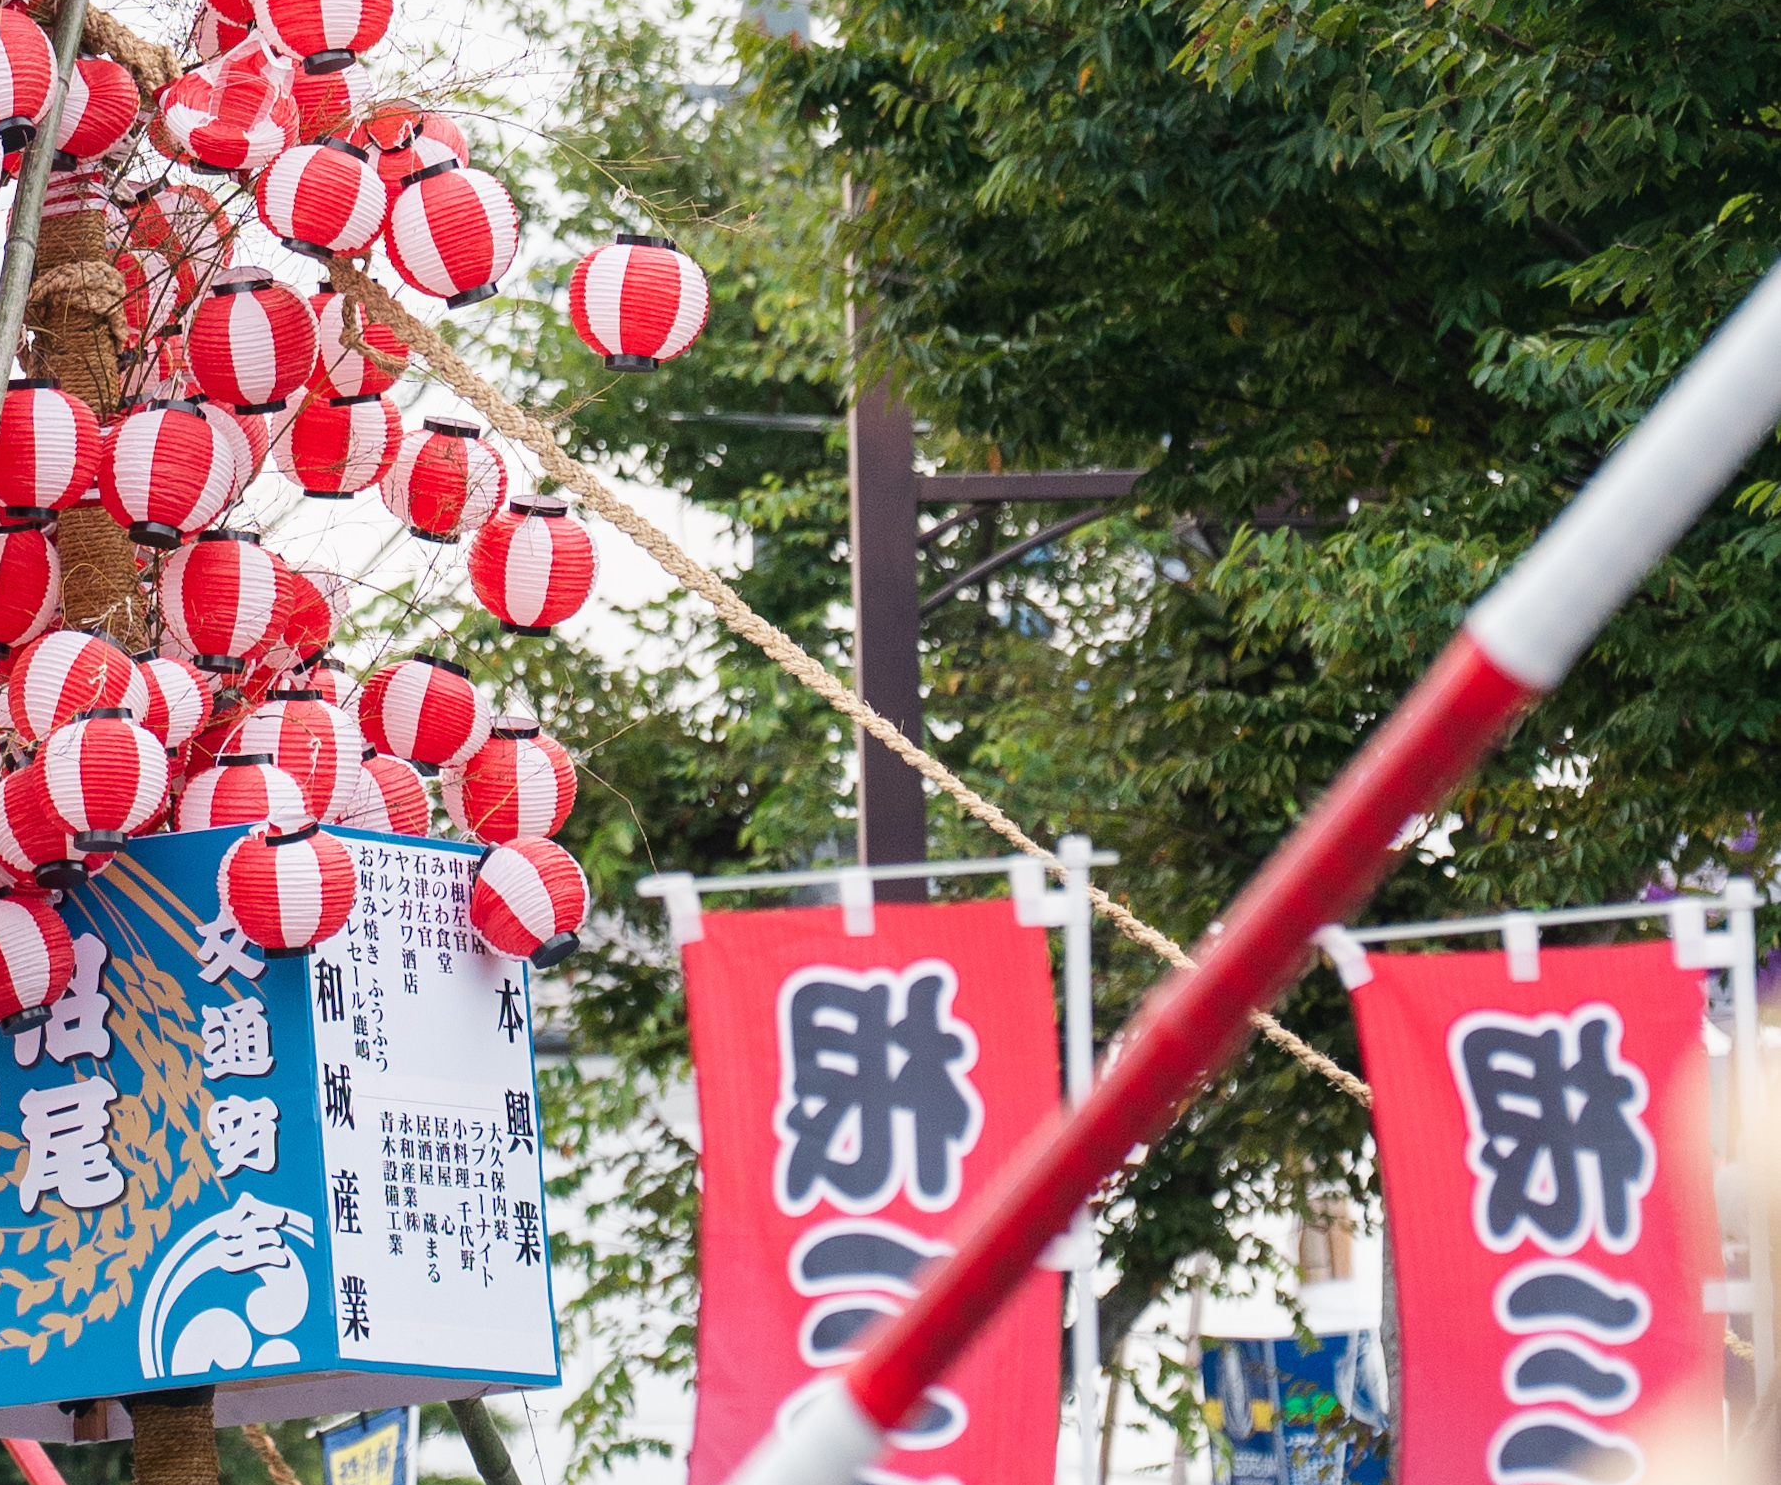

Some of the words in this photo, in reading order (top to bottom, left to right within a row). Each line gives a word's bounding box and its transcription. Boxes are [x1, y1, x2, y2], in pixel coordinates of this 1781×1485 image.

[359, 846, 380, 965] お好み焼き
[378, 848, 395, 917] ケルン
[395, 850, 418, 995] ヤタガワ酒店
[413, 855, 432, 948] 石津左官
[431, 856, 453, 974] みのわ食堂
[449, 858, 467, 953] 中根左官
[368, 979, 388, 1072] ふうふう
[380, 1111, 403, 1256] 青木設備工業
[417, 1114, 434, 1186] 居酒屋
[434, 1117, 452, 1188] 居酒屋
[452, 1119, 470, 1189] 小料理
[488, 1123, 509, 1241] 大久保内装
[422, 1213, 440, 1283] 蔵まる
[441, 1214, 455, 1236] 心
[457, 1201, 475, 1272] 千代野
